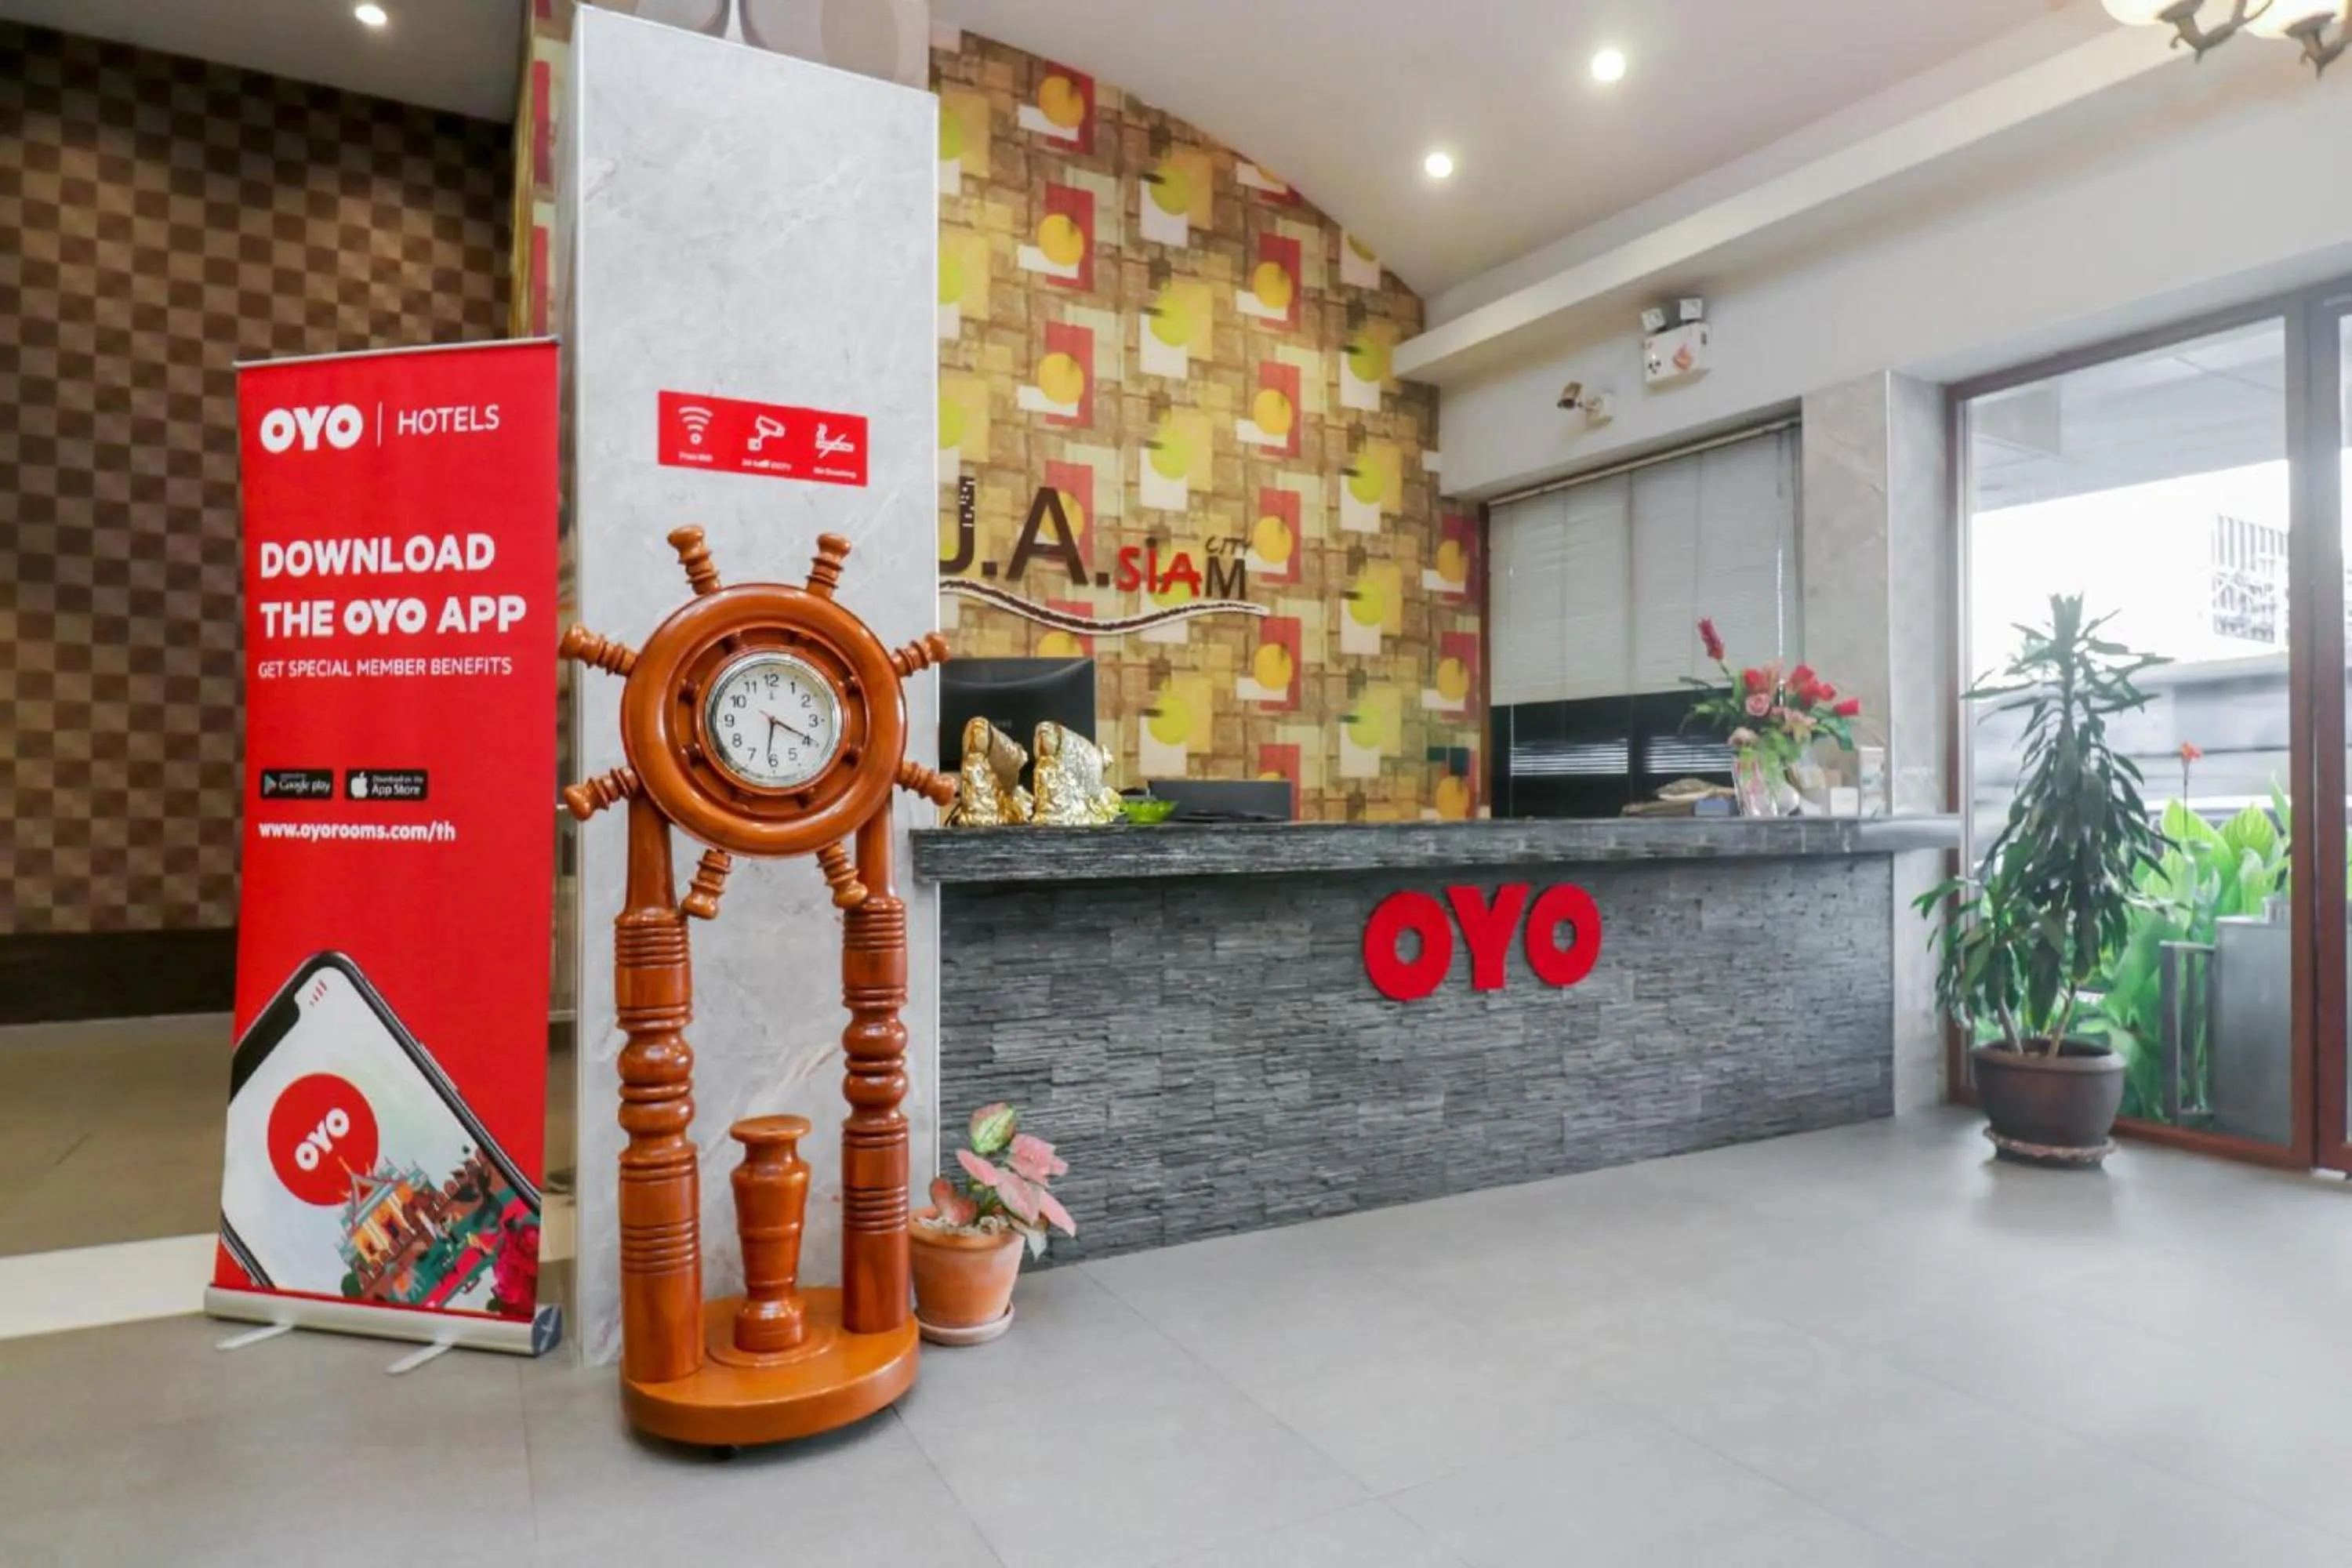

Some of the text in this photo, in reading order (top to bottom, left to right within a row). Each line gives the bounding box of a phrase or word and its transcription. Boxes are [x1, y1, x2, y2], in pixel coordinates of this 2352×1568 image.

[260, 404, 499, 453] OYO HOTELS
[260, 533, 495, 579] DOWNLOAD
[260, 594, 526, 638] THE OYO APP
[258, 657, 513, 678] GET SPECIAL MEMBER BENEFITS
[745, 681, 757, 694] 11
[763, 673, 779, 688] 12
[790, 681, 796, 695] 1
[731, 695, 746, 709] 10
[801, 695, 811, 708] 2
[724, 714, 735, 728] 9
[808, 714, 818, 728] 3
[732, 733, 742, 747] 8
[802, 735, 811, 746] 4
[748, 747, 757, 761] 7
[768, 753, 779, 768] 6
[788, 748, 797, 760] 5
[372, 785, 421, 797] App Store
[259, 821, 456, 842] www.oyorooms.com/th
[1363, 881, 1602, 1002] OYO
[295, 1107, 350, 1171] OYO
